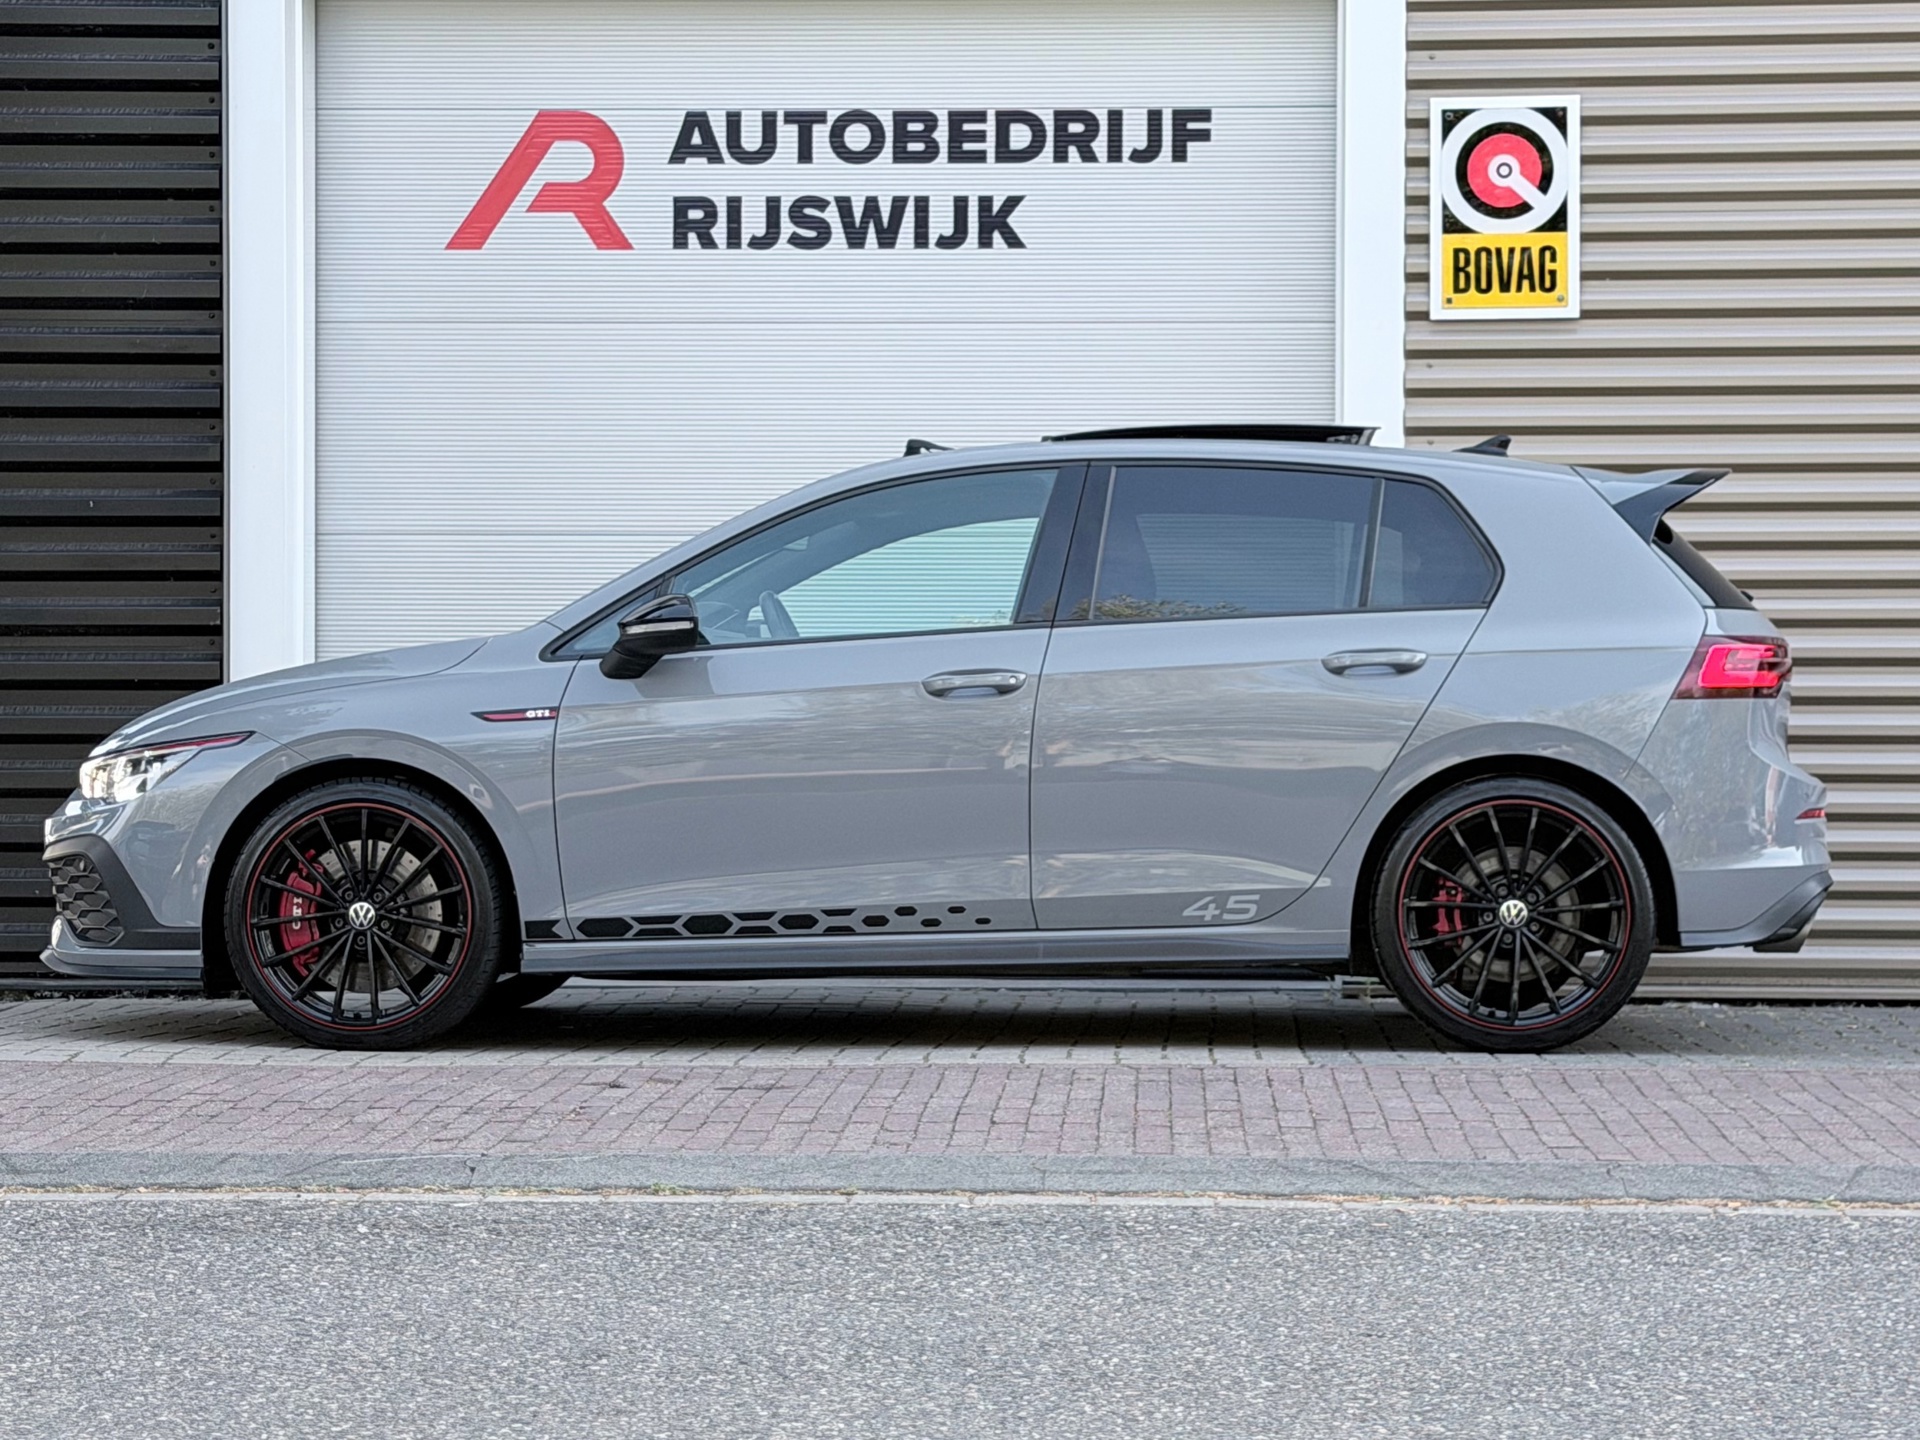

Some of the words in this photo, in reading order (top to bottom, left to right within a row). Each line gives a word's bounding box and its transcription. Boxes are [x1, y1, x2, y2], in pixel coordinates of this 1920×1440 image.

[667, 109, 1212, 165] AUTOBEDRIJF
[672, 195, 1027, 250] RIJSWIJK
[1452, 245, 1557, 294] BOVAG
[525, 709, 550, 718] GTI
[1182, 894, 1260, 921] 45
